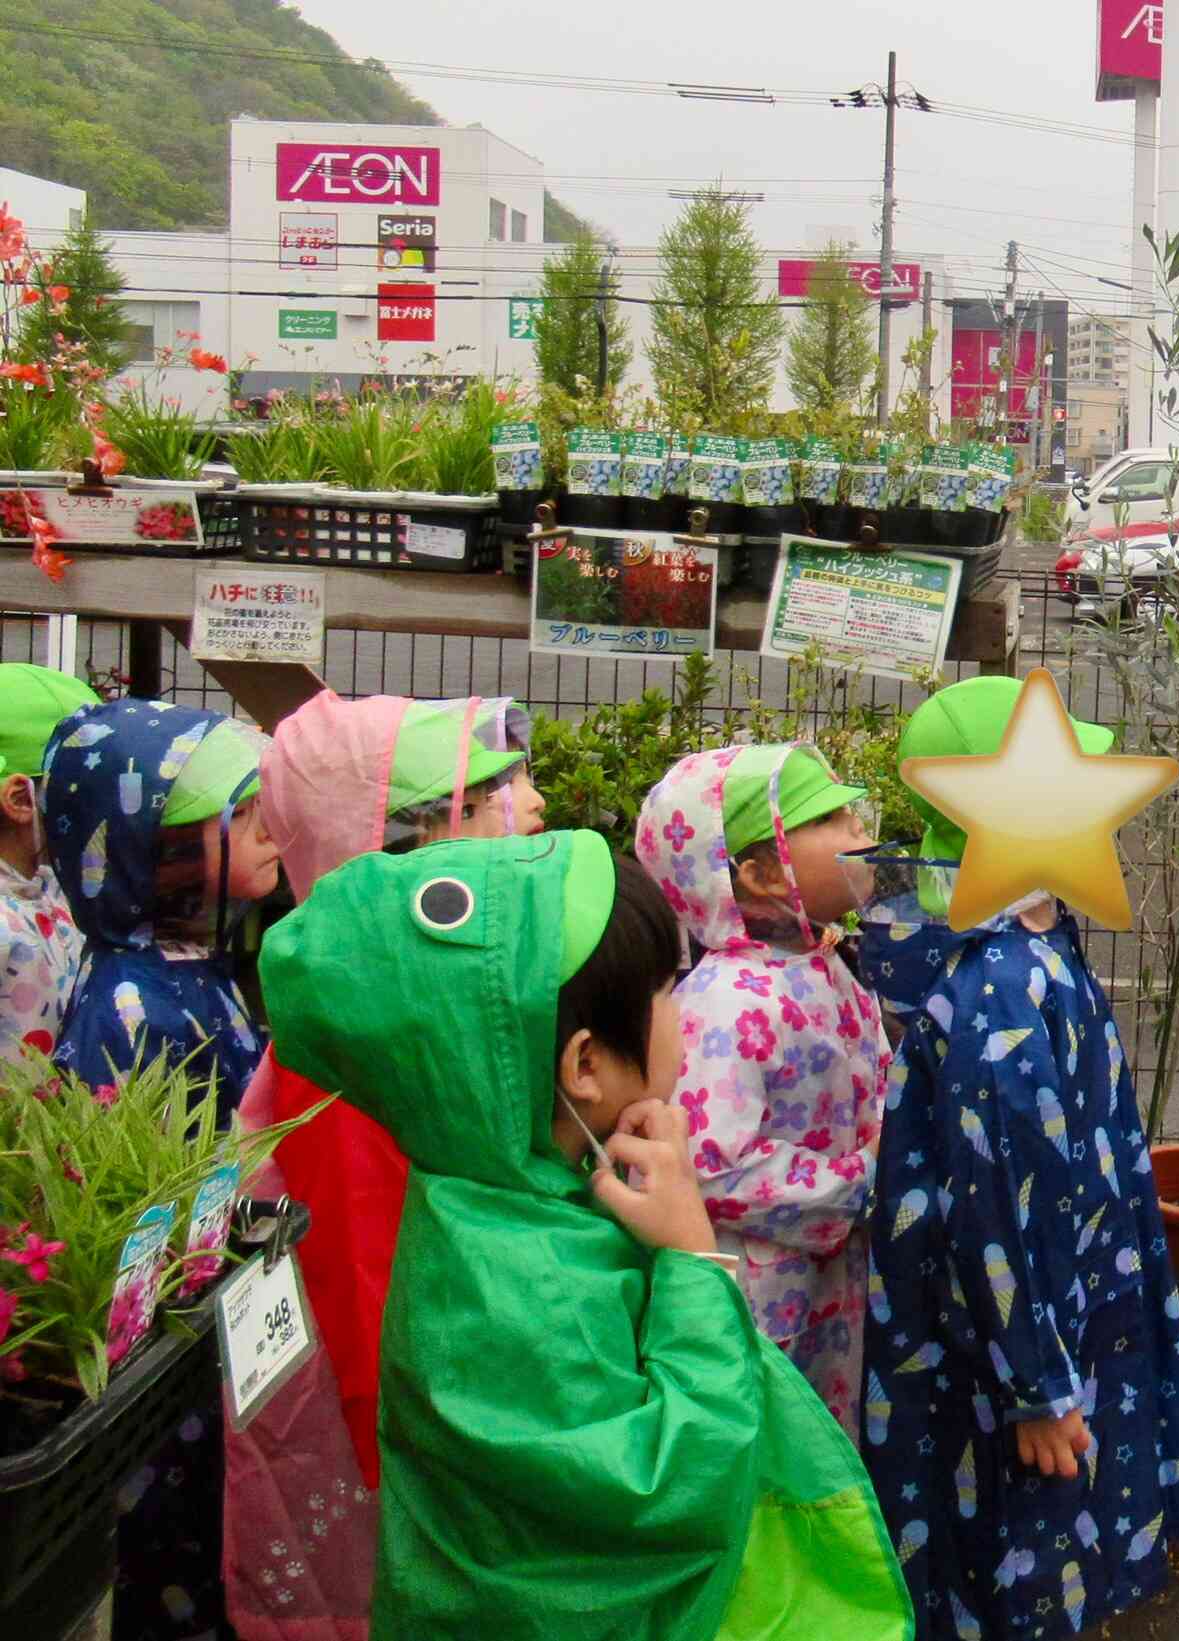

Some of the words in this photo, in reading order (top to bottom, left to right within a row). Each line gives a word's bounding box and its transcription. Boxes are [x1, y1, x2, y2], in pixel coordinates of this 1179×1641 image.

[380, 219, 433, 236] Seria
[379, 306, 433, 319] 富士メガネ
[57, 497, 143, 508] ヒメヒオウギ
[626, 541, 645, 557] 秋
[841, 553, 908, 568] ブルーベリー
[580, 564, 619, 578] 楽しむ
[669, 578, 710, 593] 楽しむ
[550, 624, 697, 649] ブルーベリー
[264, 1297, 291, 1340] 348
